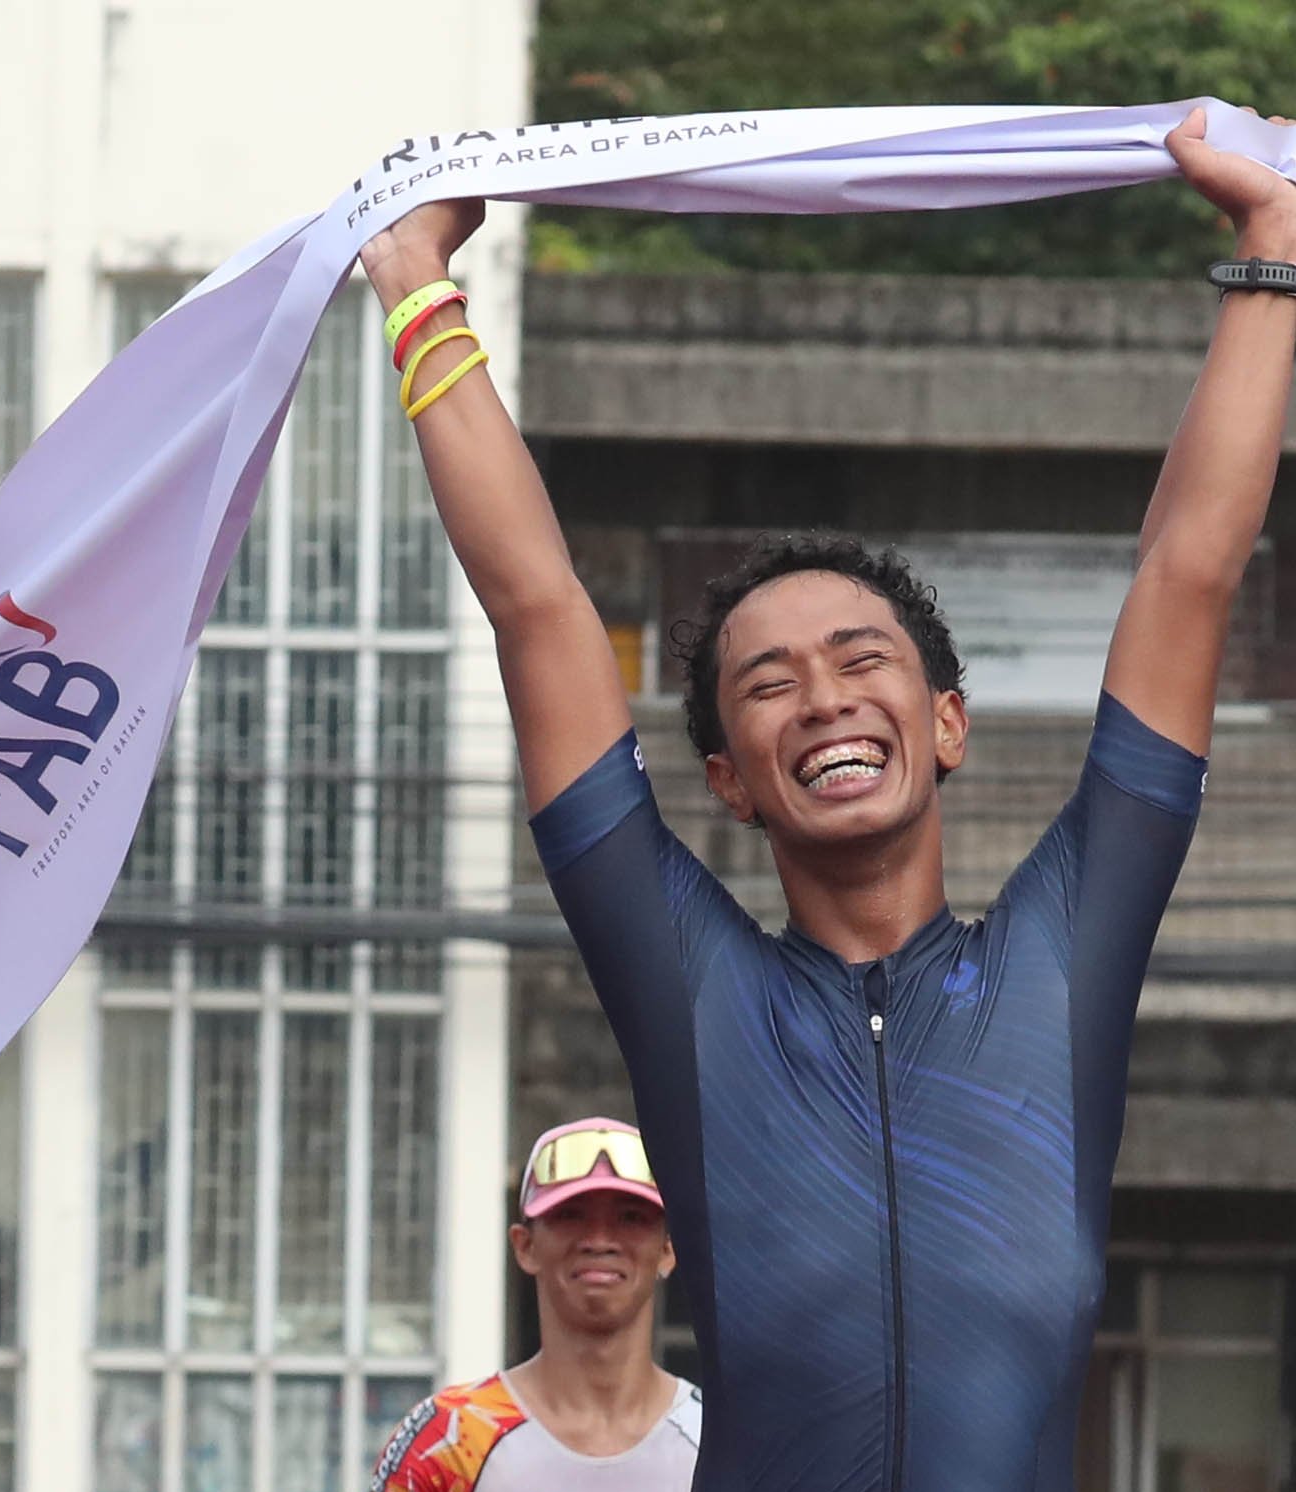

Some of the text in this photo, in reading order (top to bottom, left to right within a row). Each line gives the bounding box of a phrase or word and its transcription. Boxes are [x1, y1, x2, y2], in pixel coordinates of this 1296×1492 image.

[347, 119, 760, 229] FREEPORT AREA OF BATAAN
[32, 814, 77, 879] FREEPORT
[78, 779, 102, 812] AREA
[100, 756, 114, 777] OF
